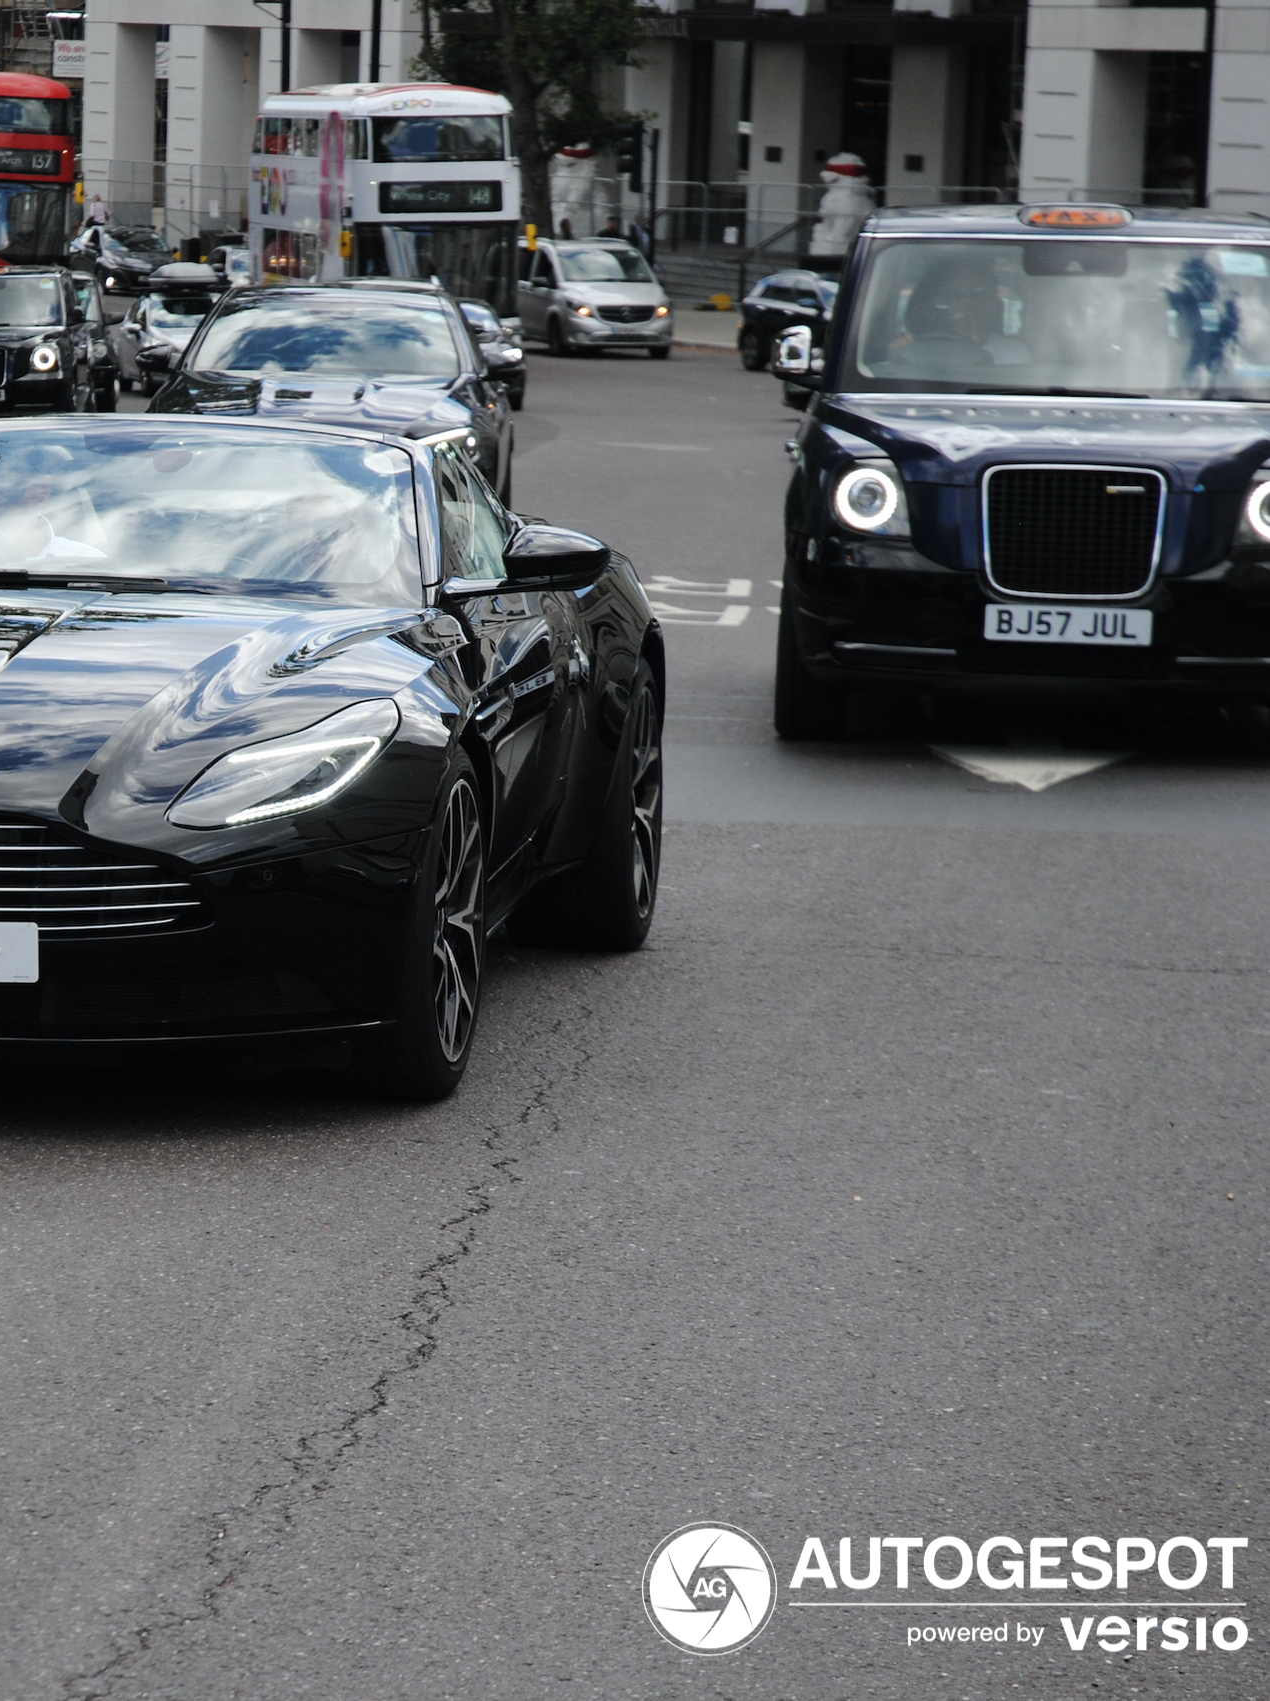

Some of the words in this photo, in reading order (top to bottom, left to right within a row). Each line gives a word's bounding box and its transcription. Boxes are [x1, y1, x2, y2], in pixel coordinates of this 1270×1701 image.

[32, 154, 53, 169] 137
[391, 191, 424, 200] White
[427, 190, 450, 202] City
[469, 186, 491, 204] 148
[1039, 209, 1115, 224] TAXI
[996, 609, 1072, 636] BJ57
[1082, 612, 1137, 639] JUL
